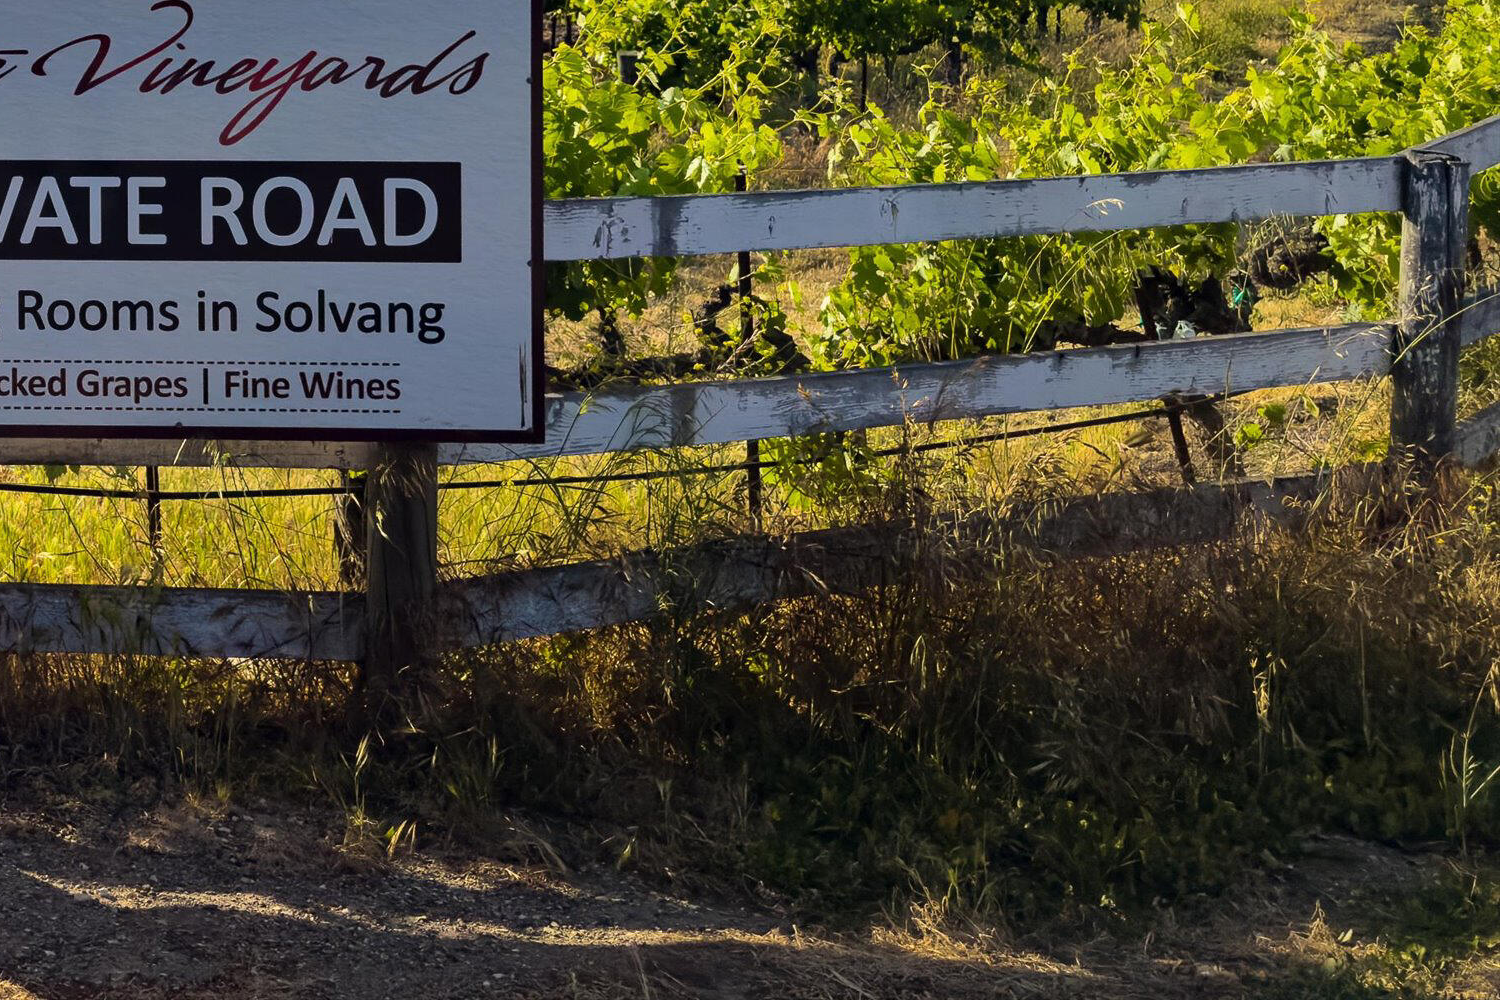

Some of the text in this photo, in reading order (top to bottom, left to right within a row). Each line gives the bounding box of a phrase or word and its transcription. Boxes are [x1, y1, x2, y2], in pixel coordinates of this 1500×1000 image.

[31, 0, 490, 146] Vineyards
[201, 177, 439, 247] ROAD
[18, 290, 180, 332] Rooms
[198, 291, 238, 332] in
[256, 289, 446, 344] Solvang
[77, 370, 188, 405] Grapes
[225, 371, 290, 399] Fine
[299, 371, 401, 400] Wines
